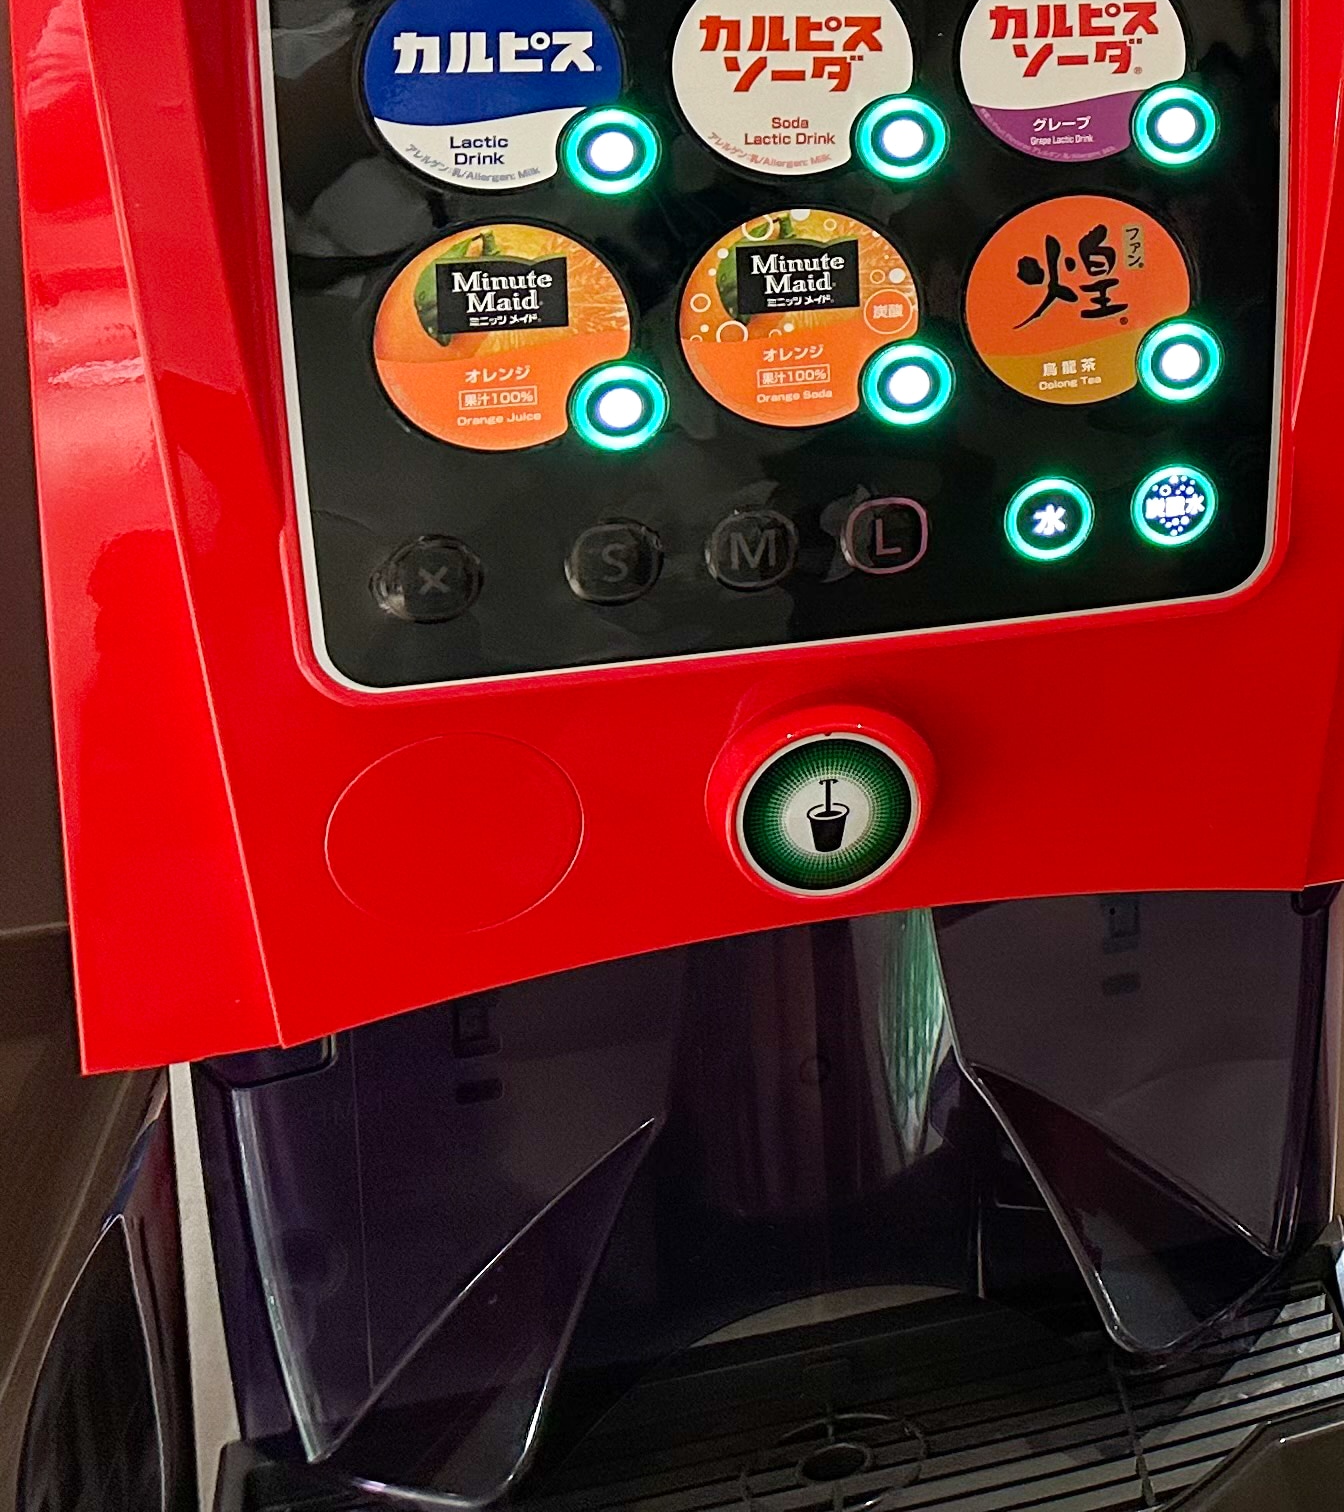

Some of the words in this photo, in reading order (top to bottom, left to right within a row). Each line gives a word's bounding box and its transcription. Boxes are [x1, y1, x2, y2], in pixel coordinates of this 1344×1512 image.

[989, 1, 1159, 40] カルピス
[699, 15, 883, 52] カルピス
[393, 31, 595, 74] カルピス
[1012, 38, 1143, 78] ソーダ
[724, 55, 864, 93] ソーダ
[771, 116, 809, 129] Soda
[1033, 115, 1091, 132] グレープ
[450, 135, 509, 149] Lactic
[744, 133, 791, 145] Lactic
[796, 133, 835, 145] Drink
[1030, 136, 1052, 146] Grape
[1052, 136, 1073, 145] Lactic
[1075, 134, 1093, 144] Drink
[454, 152, 504, 166] Drink
[750, 253, 845, 275] Minute
[451, 271, 553, 293] Minute
[764, 272, 832, 294] Maid
[466, 290, 540, 314] Maid
[763, 344, 824, 362] オレンジ
[464, 365, 531, 384] オレンジ
[762, 370, 827, 385] 果汁100%
[1039, 379, 1078, 391] Oolong
[1080, 375, 1102, 385] Tea
[464, 392, 534, 407] 果汁100%
[756, 392, 800, 404] Orange
[802, 389, 833, 400] Soda
[457, 415, 504, 427] Orange
[507, 412, 541, 423] Juice
[1033, 503, 1067, 536] 水
[873, 518, 901, 555] L
[729, 529, 777, 571] M
[601, 544, 630, 583] S
